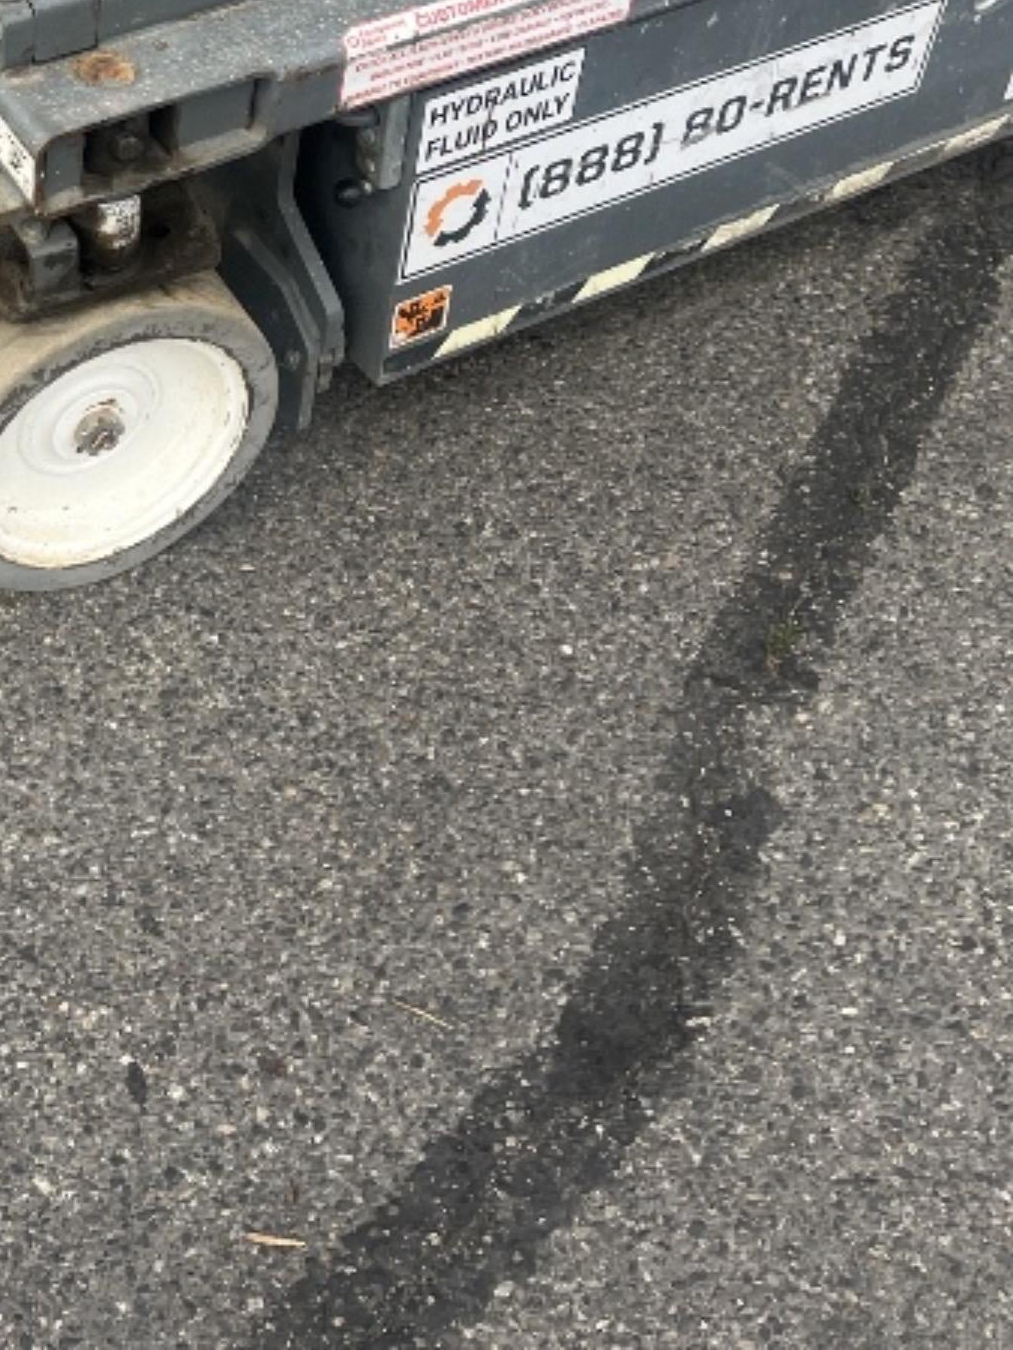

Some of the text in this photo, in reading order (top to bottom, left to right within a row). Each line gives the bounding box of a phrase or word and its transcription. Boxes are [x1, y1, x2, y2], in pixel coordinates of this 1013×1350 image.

[425, 92, 570, 162] FLUID ONLY
[429, 60, 576, 128] HYDRAULIC
[519, 122, 665, 210] (888)
[680, 34, 916, 150] 80-RENTS
